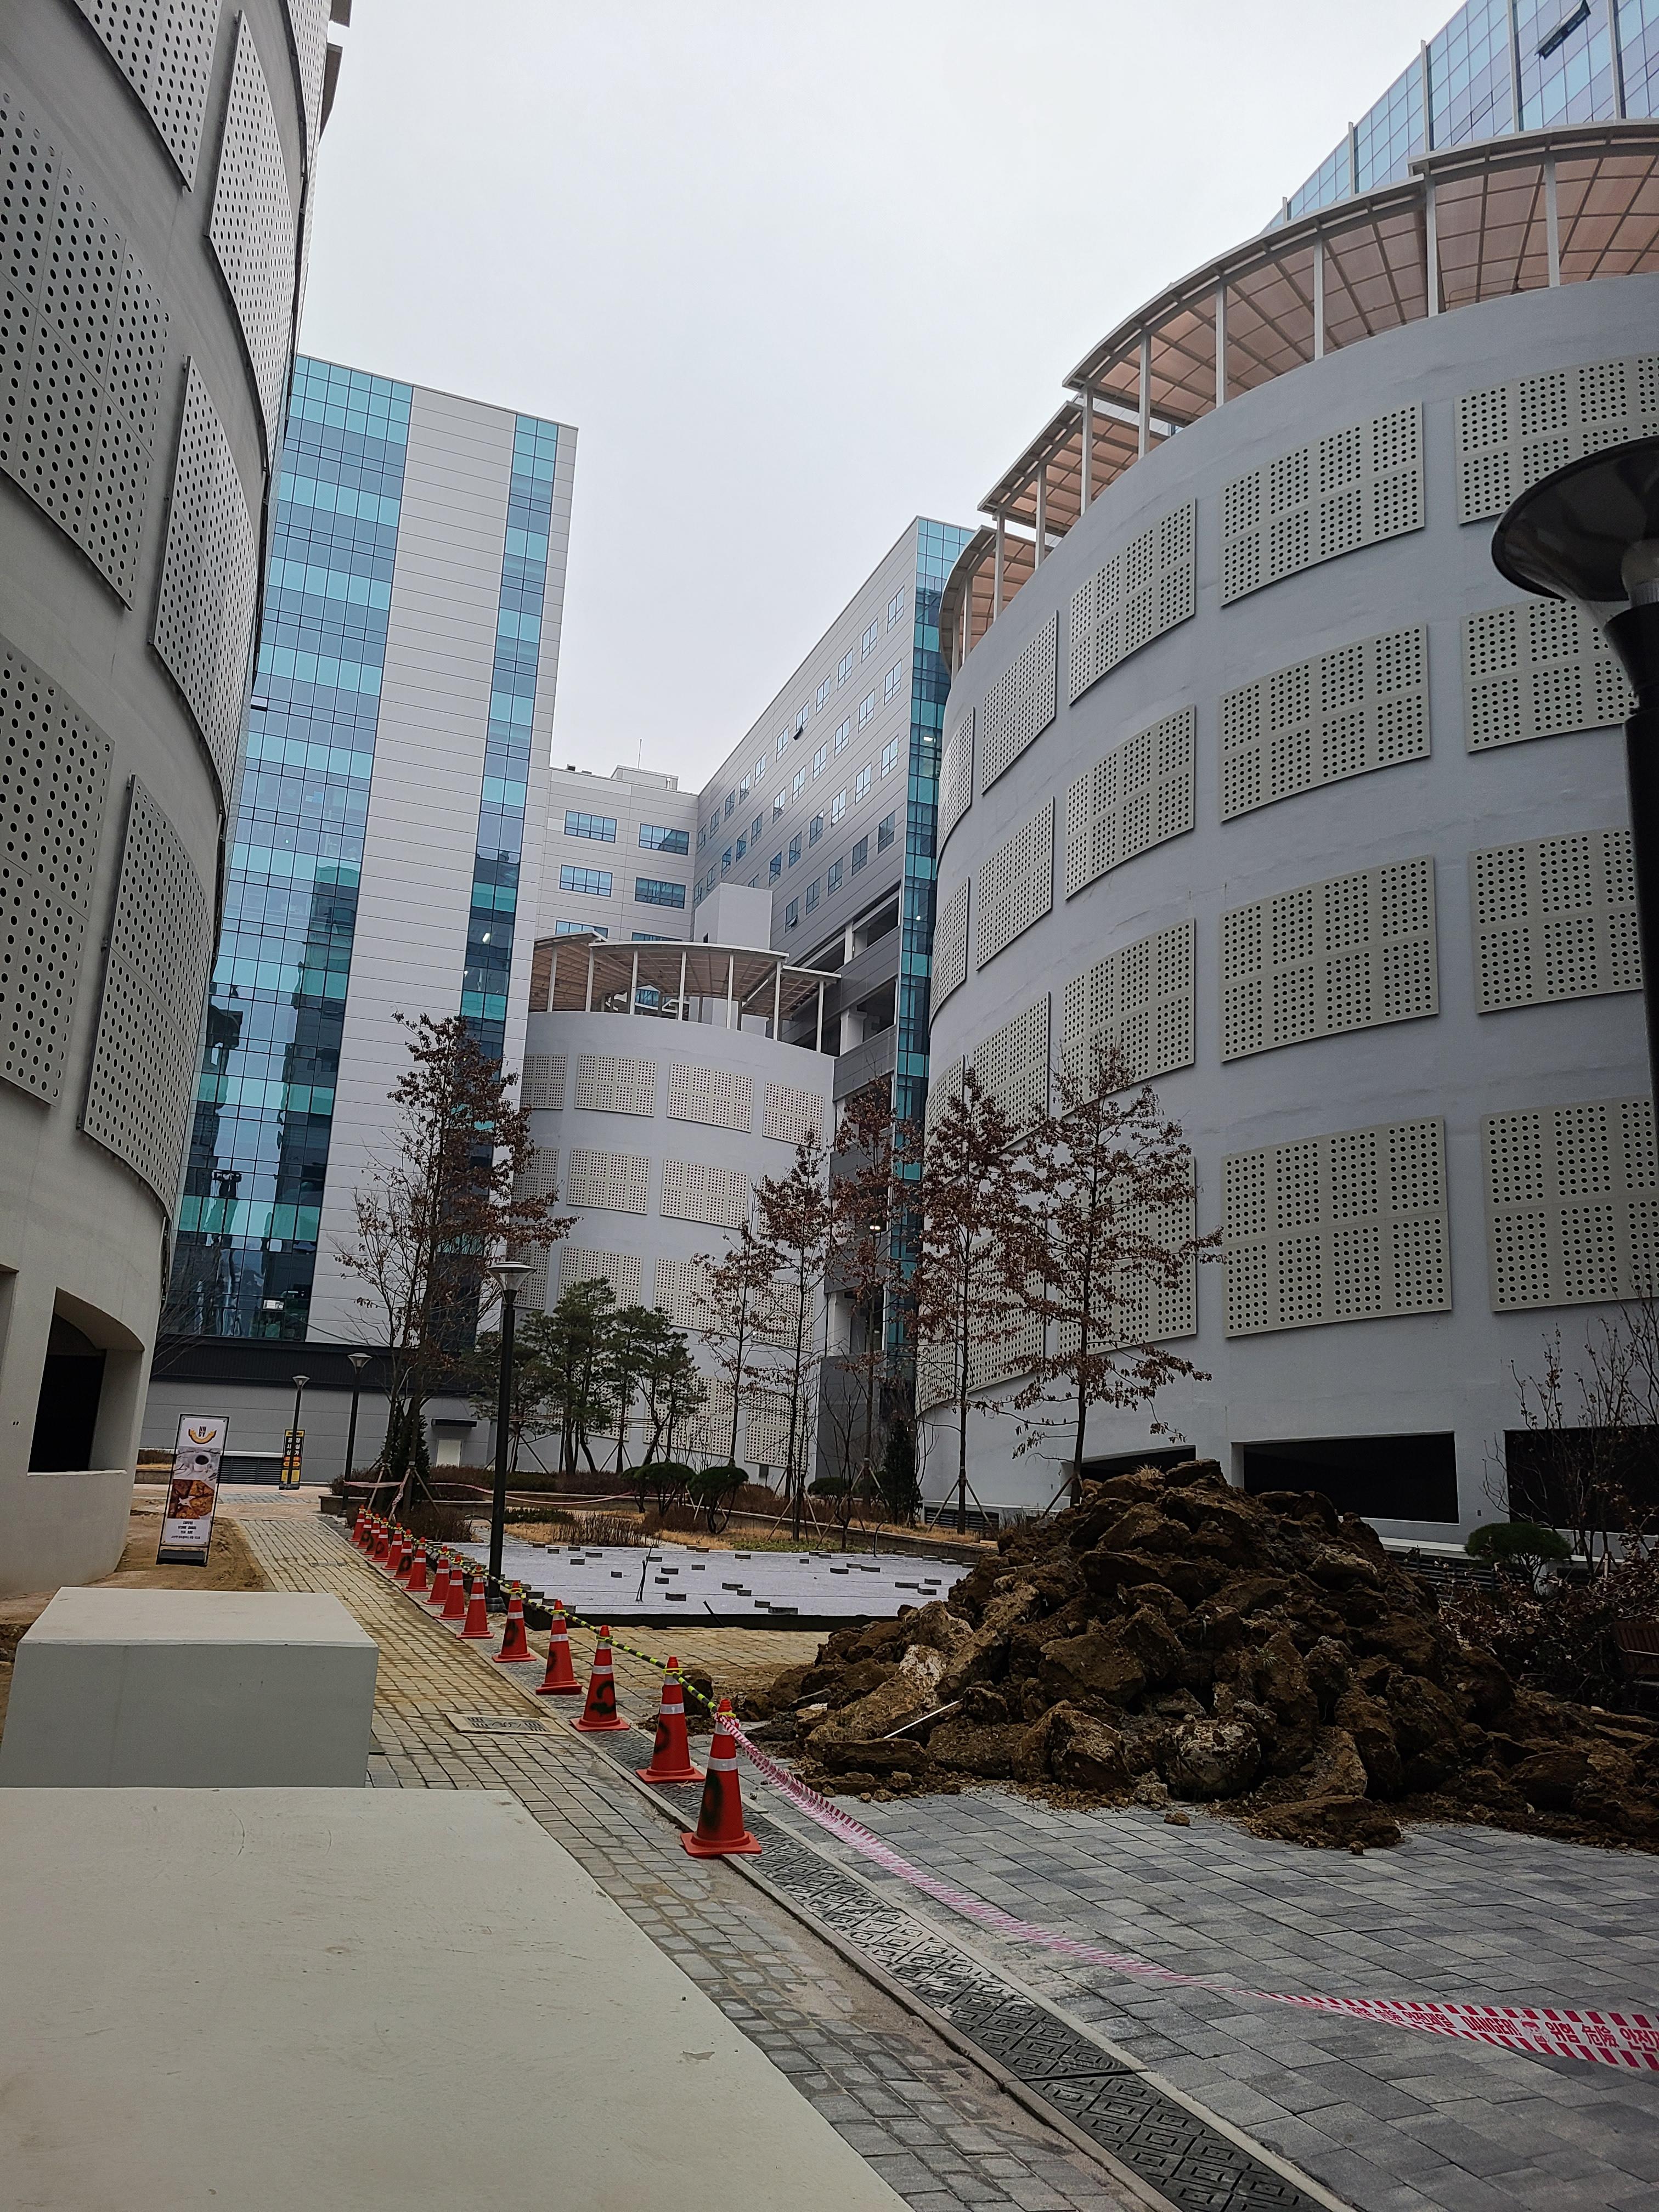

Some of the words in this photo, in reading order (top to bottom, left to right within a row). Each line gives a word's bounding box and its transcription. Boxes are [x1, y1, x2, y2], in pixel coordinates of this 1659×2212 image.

[1402, 2011, 1458, 2029] 안전제일
[1459, 2016, 1522, 2036] DANGER!
[1545, 2022, 1581, 2044] 위험
[1581, 2024, 1620, 2048] 危險
